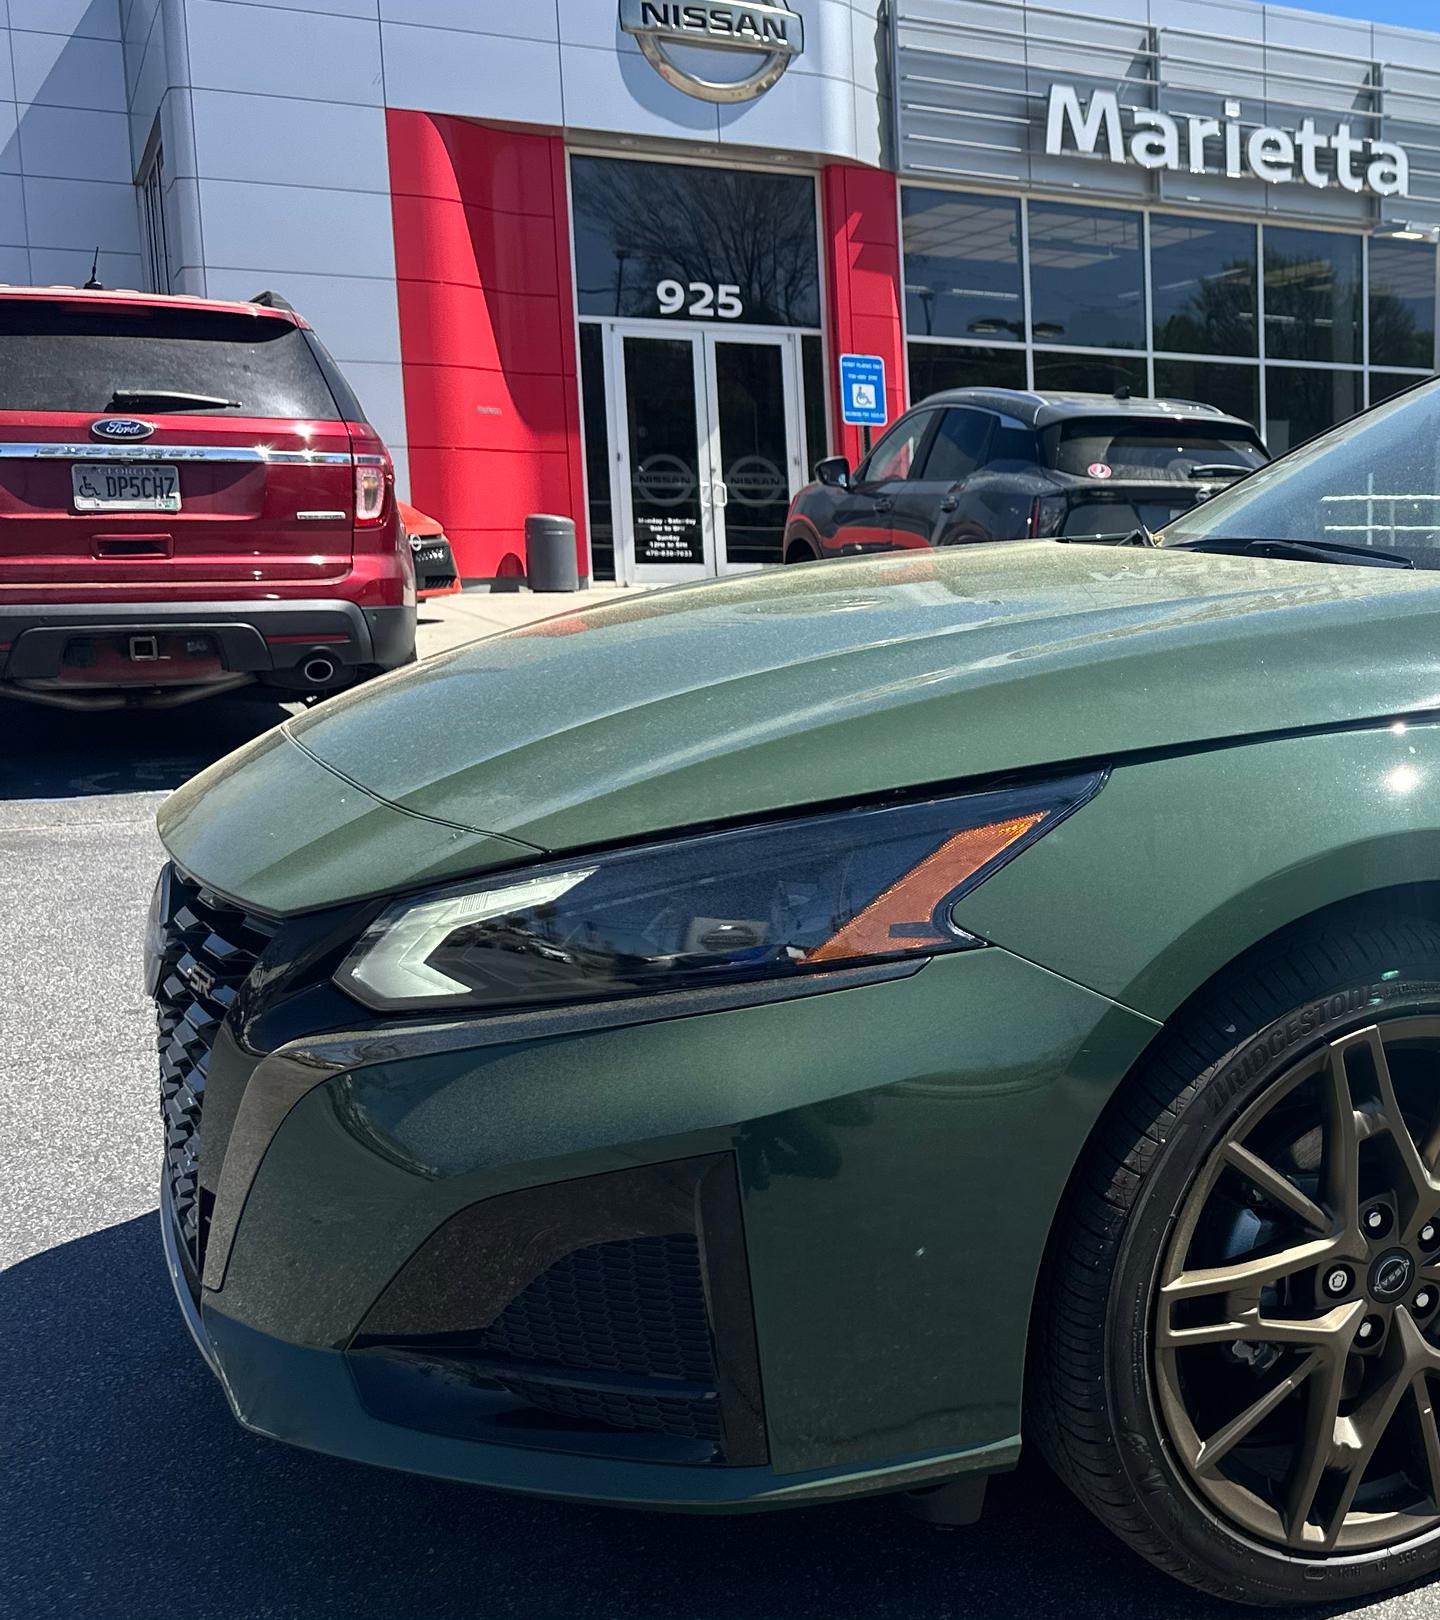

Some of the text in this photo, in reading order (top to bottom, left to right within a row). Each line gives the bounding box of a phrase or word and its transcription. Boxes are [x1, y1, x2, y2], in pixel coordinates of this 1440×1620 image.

[641, 2, 788, 44] NISSAN
[1045, 83, 1409, 196] Marietta
[656, 279, 743, 319] 925
[105, 420, 141, 435] Ford
[106, 475, 177, 500] DP5CHZ
[638, 475, 691, 485] NISSAN
[730, 476, 781, 486] NISSAN
[190, 963, 215, 1000] SR
[1203, 982, 1382, 1114] BRIDGESTONE
[1373, 1259, 1410, 1292] NISSAN
